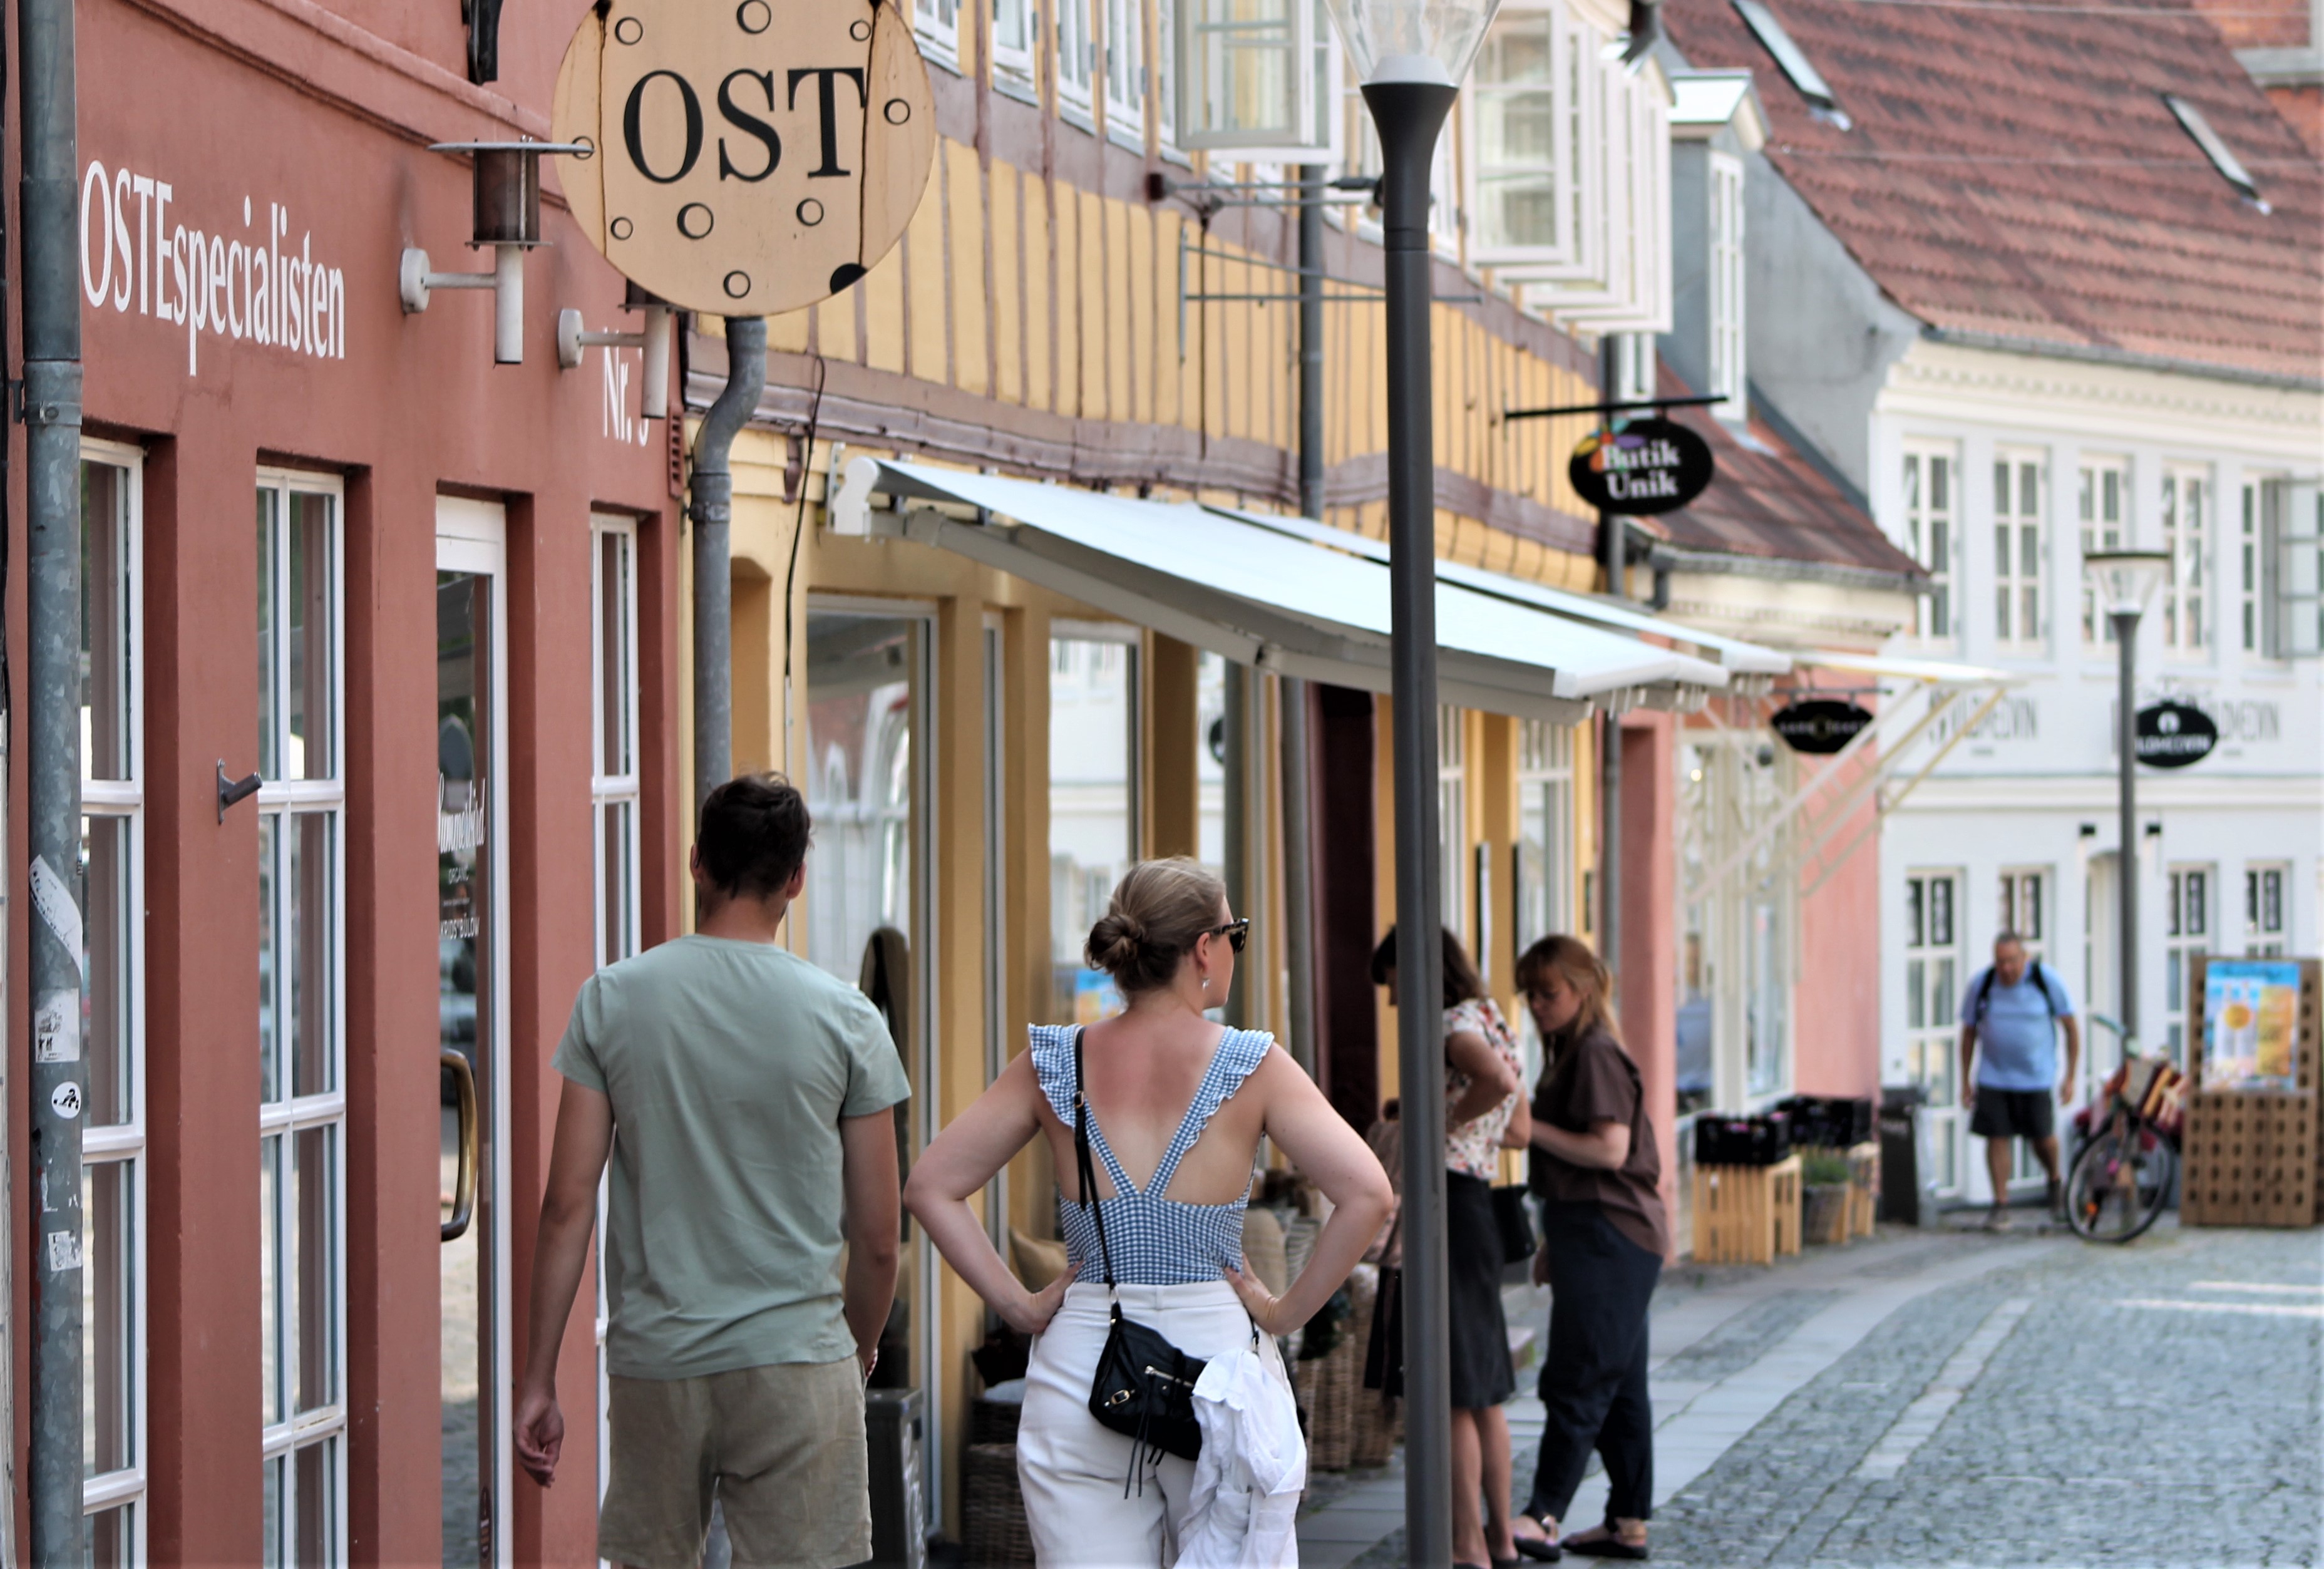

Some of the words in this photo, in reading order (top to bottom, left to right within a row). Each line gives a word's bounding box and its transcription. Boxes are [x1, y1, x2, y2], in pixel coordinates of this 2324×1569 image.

[624, 68, 868, 184] OST
[81, 160, 345, 377] OSTEspecialisten
[1607, 470, 1679, 500] Unik
